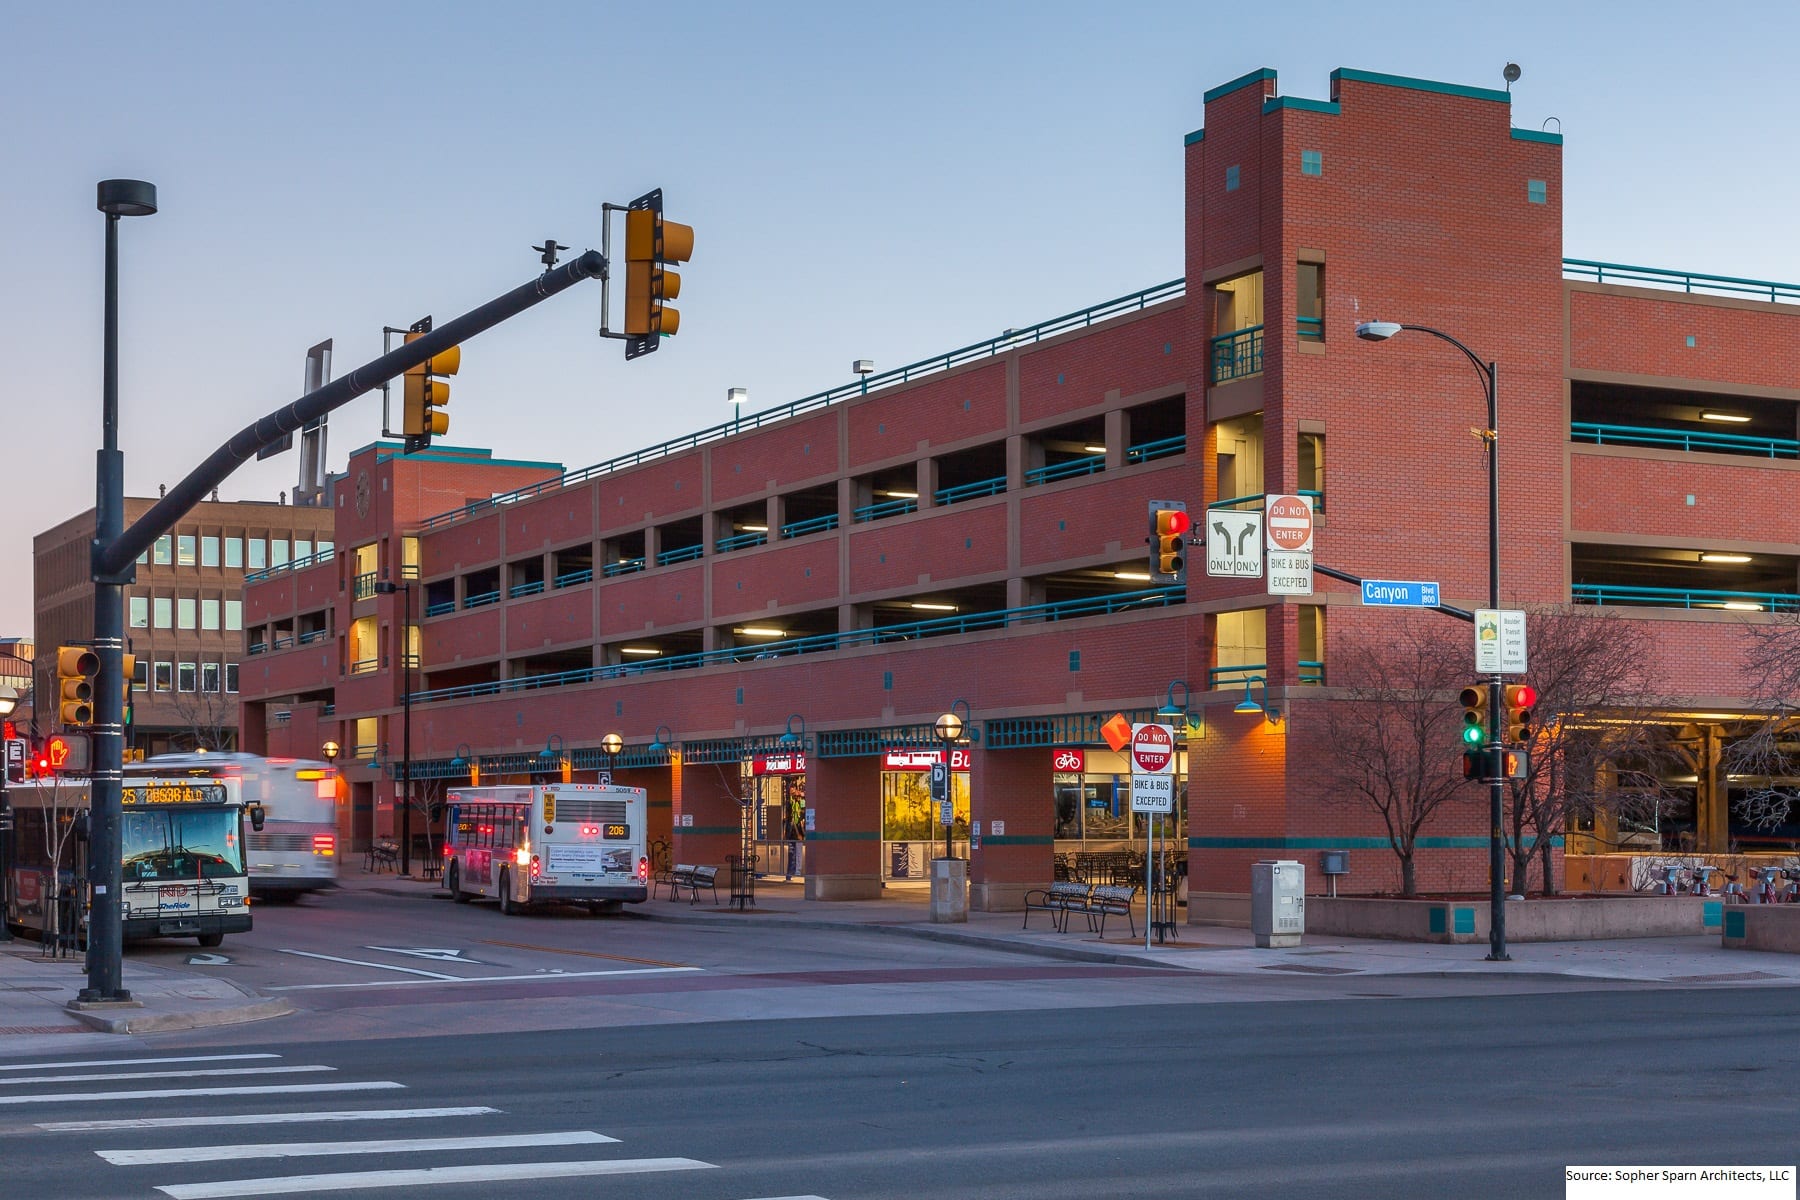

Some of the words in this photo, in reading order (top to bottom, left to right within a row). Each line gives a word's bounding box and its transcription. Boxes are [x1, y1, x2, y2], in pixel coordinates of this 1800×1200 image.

[1273, 506, 1284, 515] DO
[1289, 507, 1306, 516] NOT
[1276, 530, 1304, 540] ENTER
[1210, 560, 1233, 571] ONLY
[1236, 561, 1259, 572] ONLY
[1271, 558, 1286, 569] BIKE
[1288, 559, 1293, 569] &
[1295, 559, 1310, 570] BUS
[1273, 577, 1308, 588] EXCEPTED
[1366, 583, 1408, 603] Canyon
[1421, 586, 1434, 594] Blvd
[1422, 595, 1436, 604] 1800
[1138, 733, 1148, 742] DO
[1152, 734, 1167, 743] NOT
[10, 745, 21, 760] E
[1140, 754, 1164, 763] ENTER
[934, 768, 943, 781] D
[600, 777, 609, 785] C
[1134, 780, 1148, 790] BIKE
[1150, 780, 1155, 790] &
[1156, 781, 1169, 790] BUS
[1136, 796, 1167, 807] EXCEPTED
[608, 826, 624, 835] 206
[159, 902, 190, 911] TheRide
